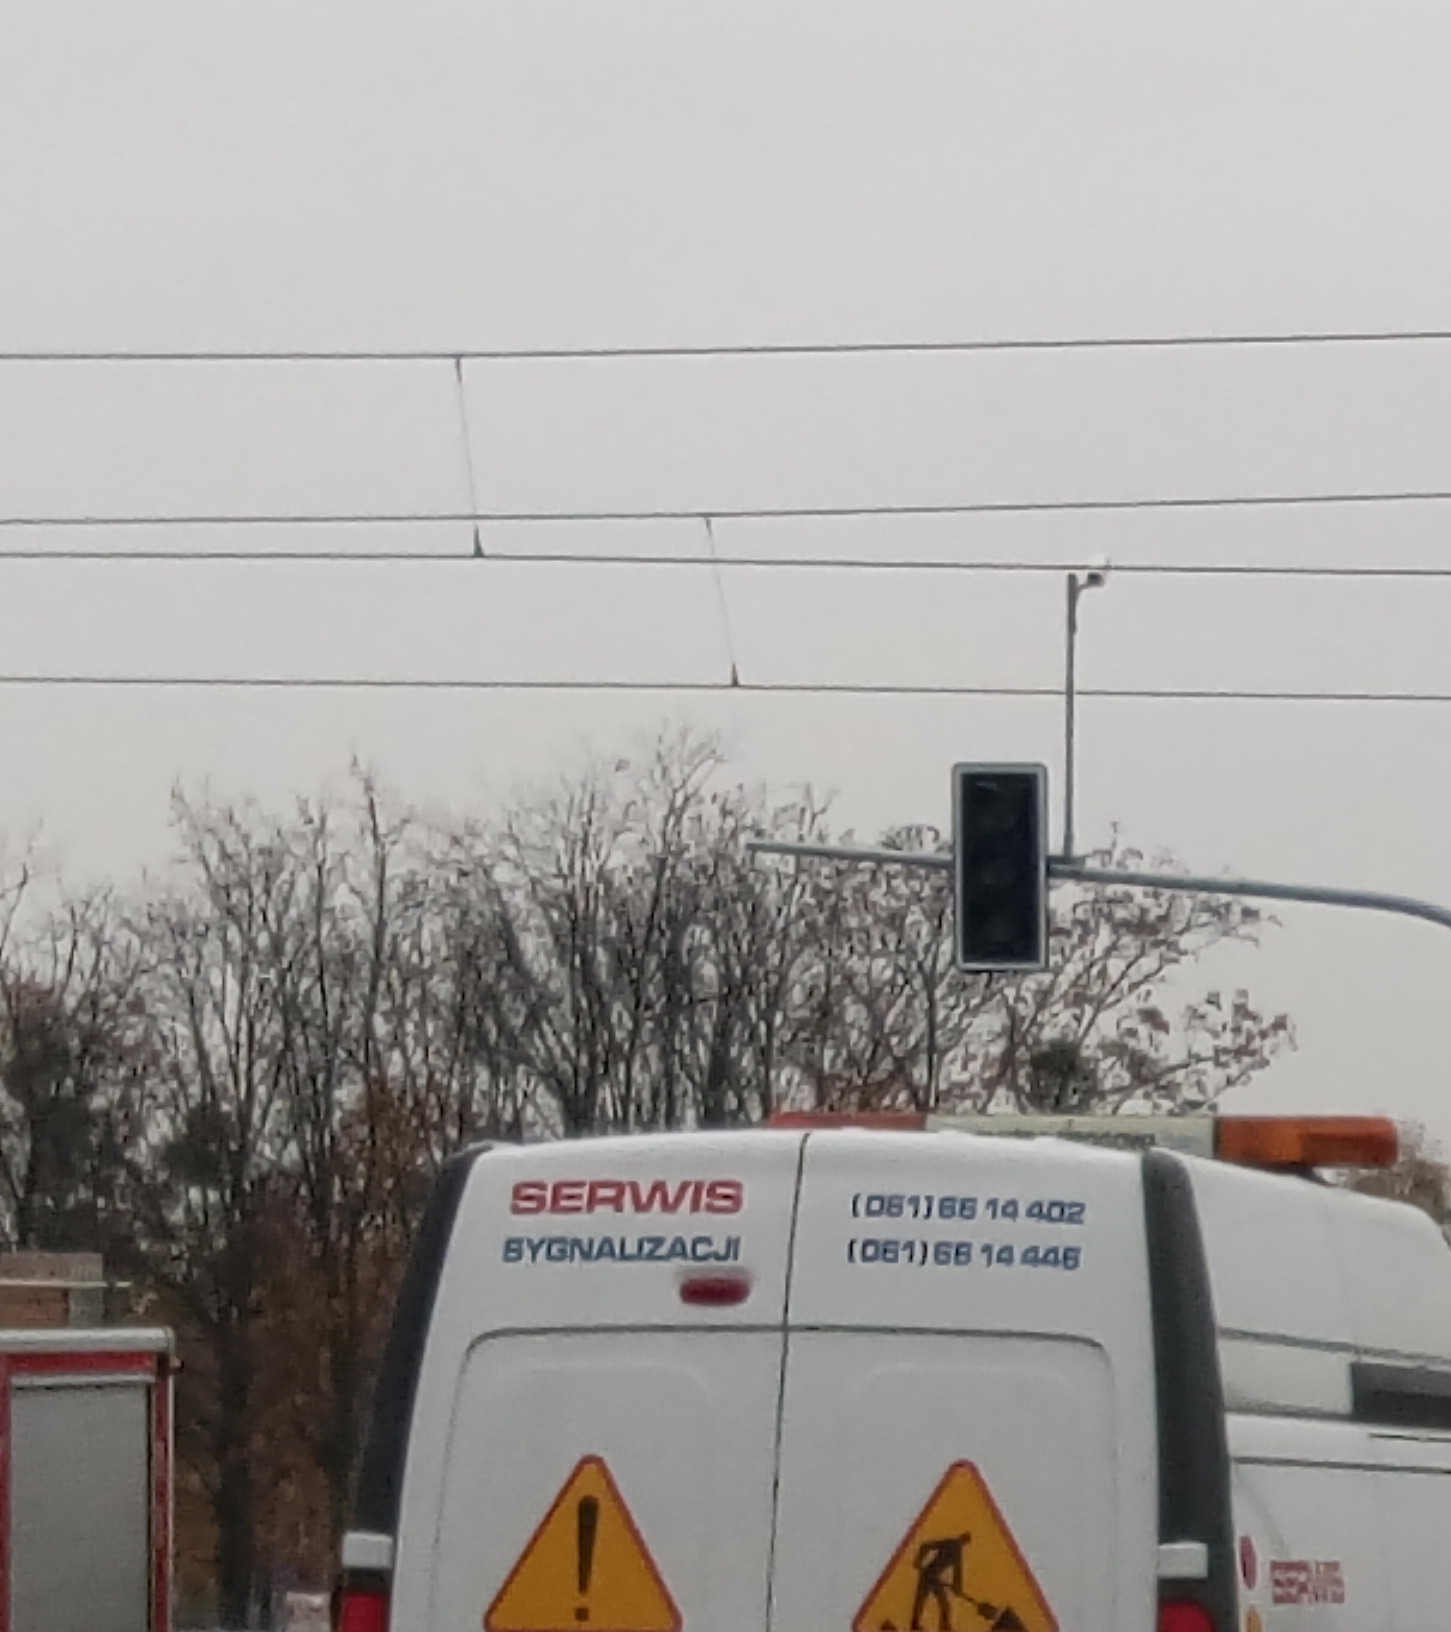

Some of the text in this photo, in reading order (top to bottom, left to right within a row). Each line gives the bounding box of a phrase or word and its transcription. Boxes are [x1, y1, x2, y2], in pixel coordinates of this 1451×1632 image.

[510, 1180, 744, 1214] SERWIS
[985, 1198, 1018, 1221] 14
[1025, 1201, 1086, 1224] 402
[502, 1236, 741, 1262] SYGNALIZACJI
[980, 1244, 1014, 1267] 14
